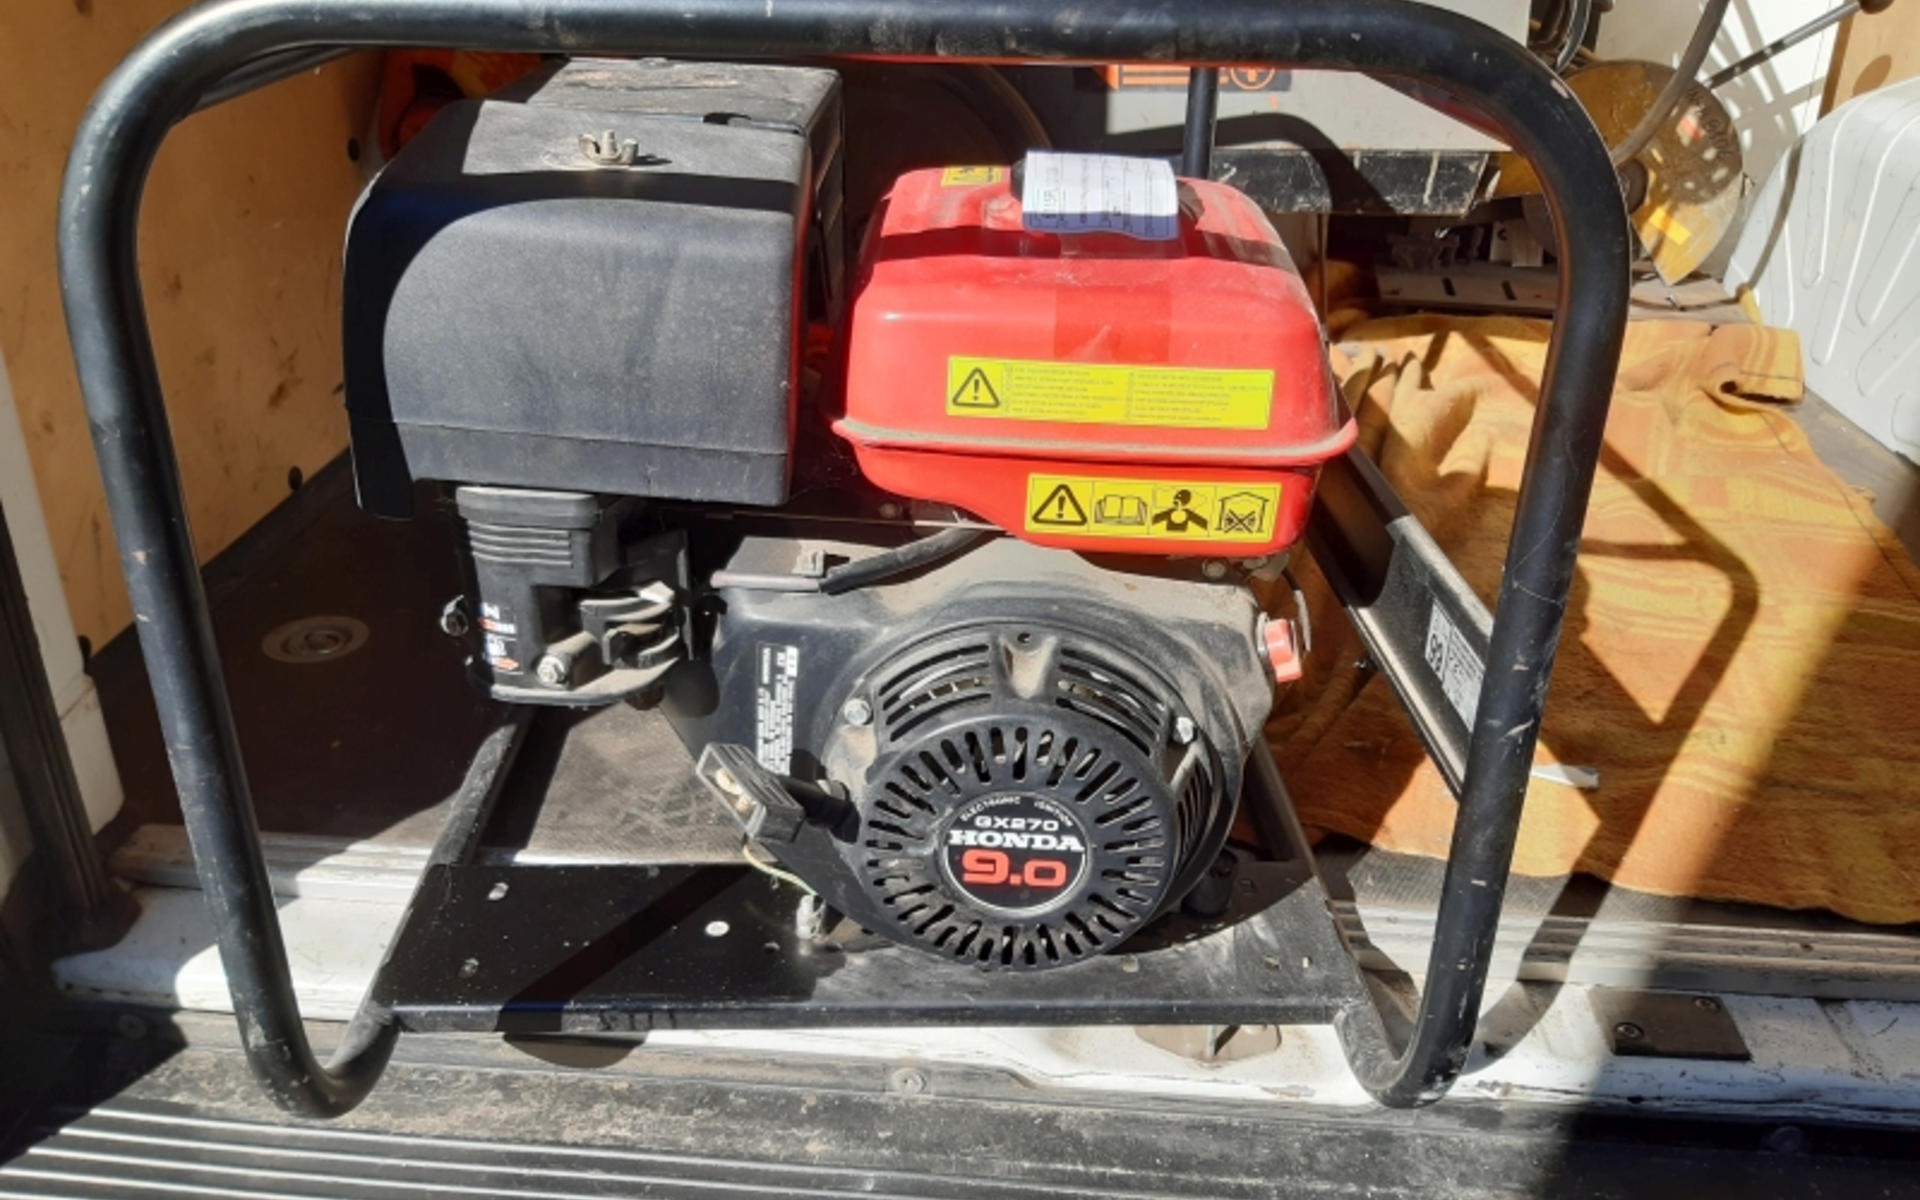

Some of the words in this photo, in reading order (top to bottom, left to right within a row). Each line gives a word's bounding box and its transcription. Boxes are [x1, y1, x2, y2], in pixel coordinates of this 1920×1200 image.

[974, 815, 1060, 832] GX270
[949, 829, 1086, 852] HONDA
[962, 849, 1067, 887] 9.0
